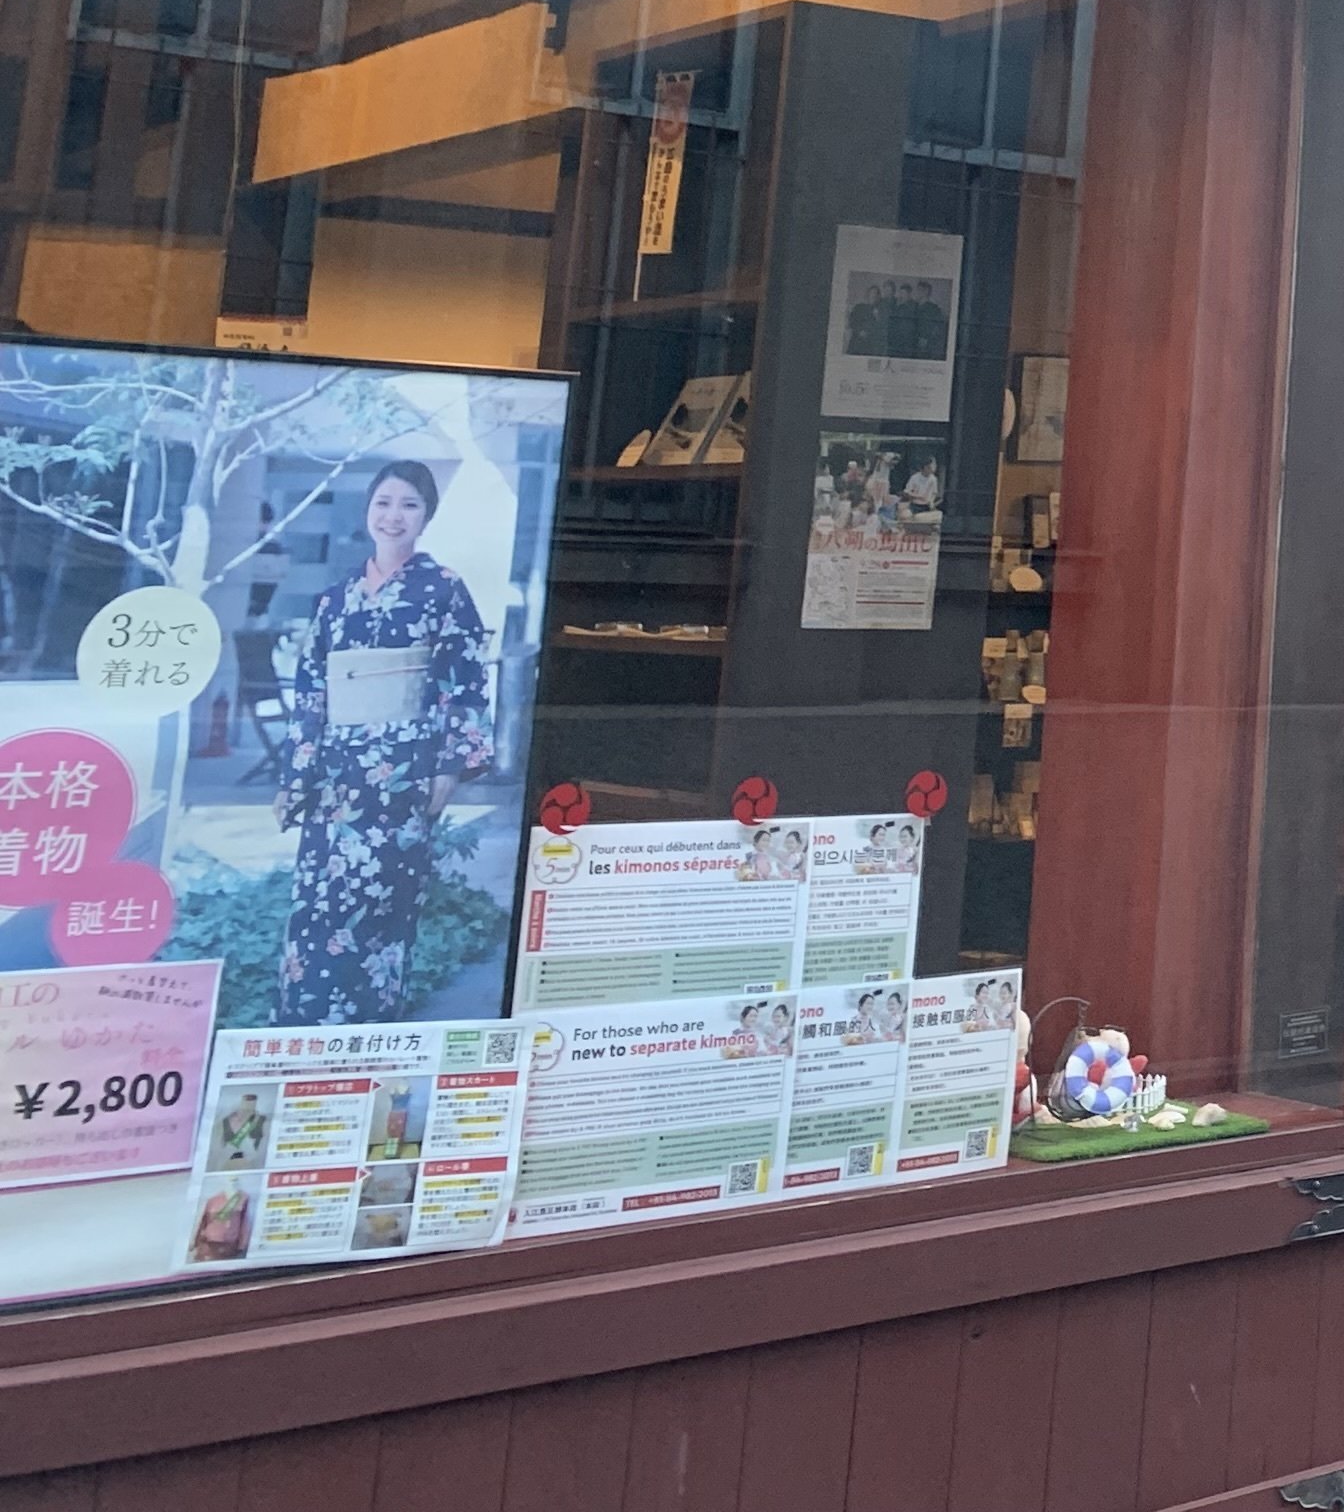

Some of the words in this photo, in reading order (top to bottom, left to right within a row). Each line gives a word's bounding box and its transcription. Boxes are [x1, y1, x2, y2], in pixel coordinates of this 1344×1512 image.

[107, 613, 198, 649] 3分で
[101, 658, 190, 689] 着れる
[0, 760, 98, 810] 本格
[591, 844, 616, 855] Pour
[619, 844, 644, 854] ceux
[647, 842, 664, 854] qui
[666, 840, 714, 852] débutent
[716, 840, 741, 850] dans
[589, 860, 611, 875] les
[614, 857, 680, 874] kimonos
[683, 855, 740, 874] séparés
[912, 994, 946, 1008] mono
[573, 1028, 599, 1042] For
[602, 1023, 643, 1039] those
[647, 1021, 679, 1036] who
[682, 1021, 705, 1034] are
[243, 1033, 422, 1058] 簡単着物の着付け方
[571, 1048, 606, 1061] new
[609, 1046, 626, 1058] to
[630, 1038, 696, 1057] separate
[700, 1033, 755, 1050] kimono
[14, 1070, 183, 1125] ¥2,800
